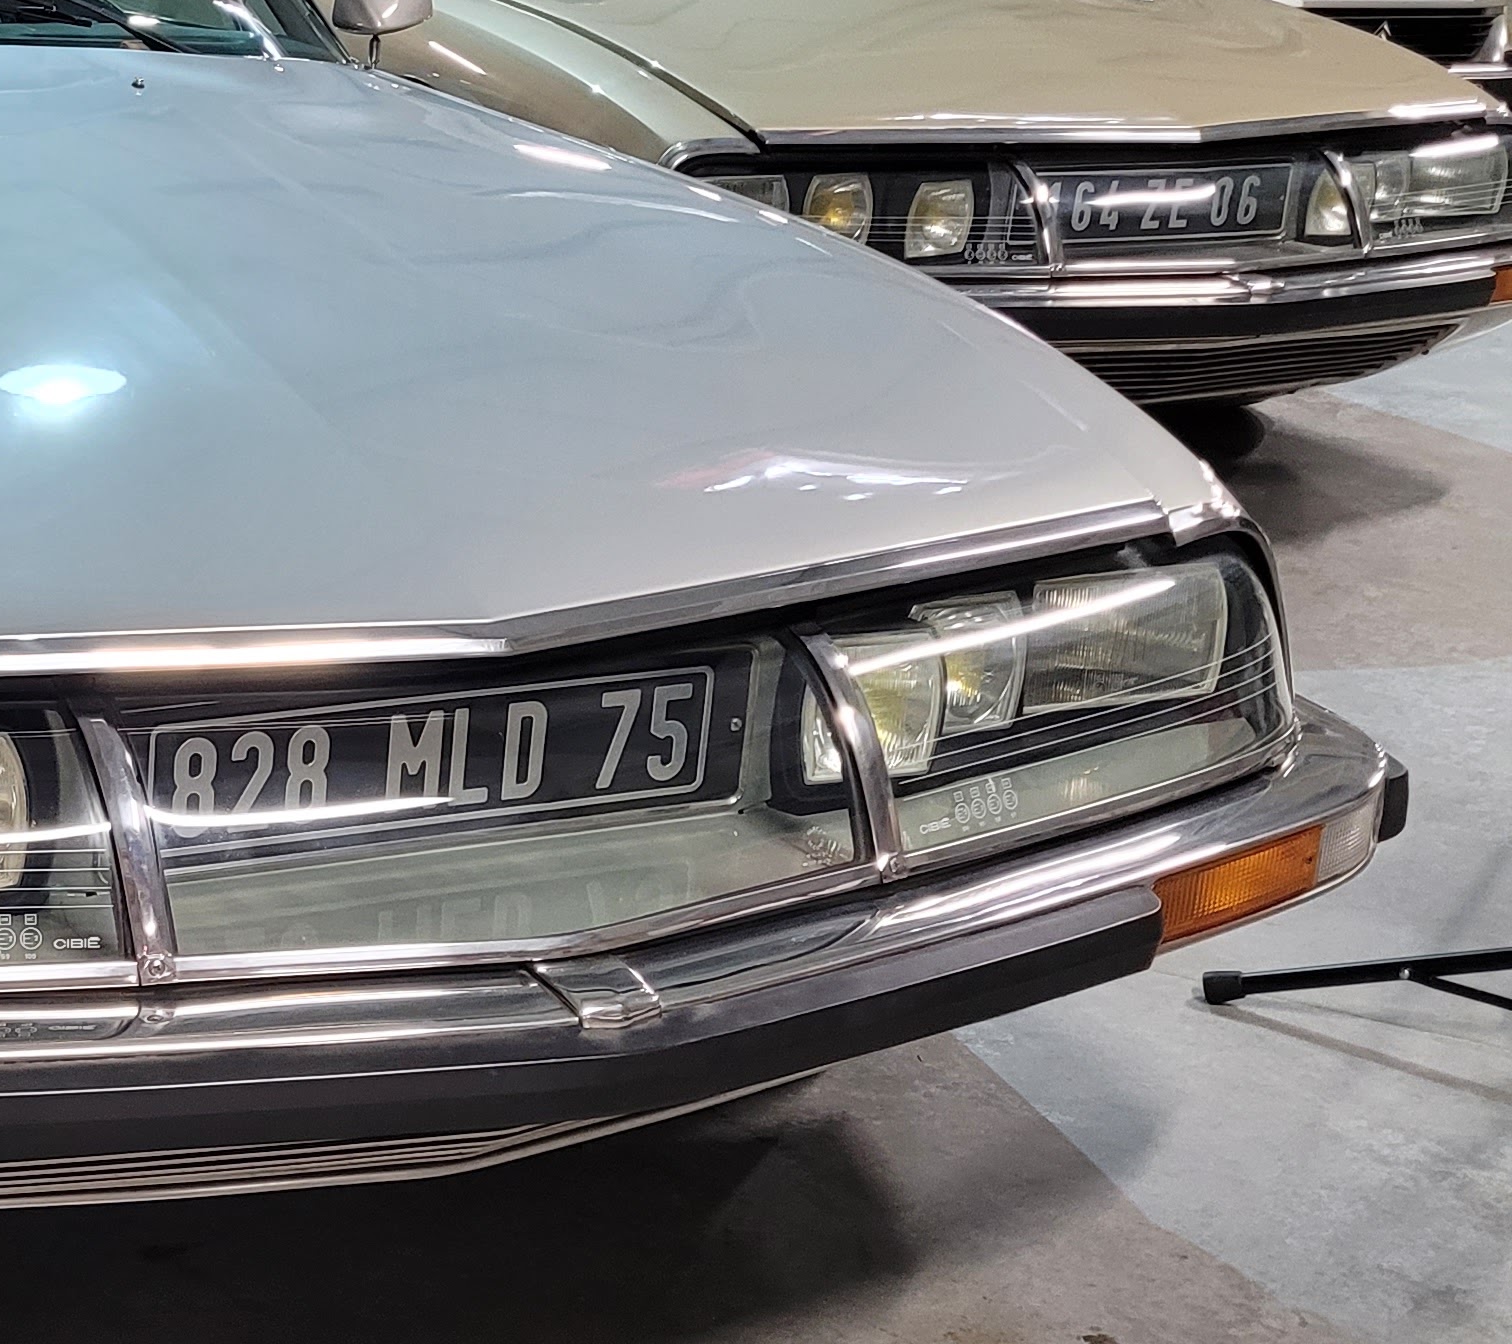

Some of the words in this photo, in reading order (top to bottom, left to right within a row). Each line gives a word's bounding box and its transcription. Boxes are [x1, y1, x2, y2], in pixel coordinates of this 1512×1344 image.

[1210, 175, 1261, 226] 06
[172, 724, 331, 837] 828
[387, 701, 548, 809] MLD
[595, 681, 693, 789] 75
